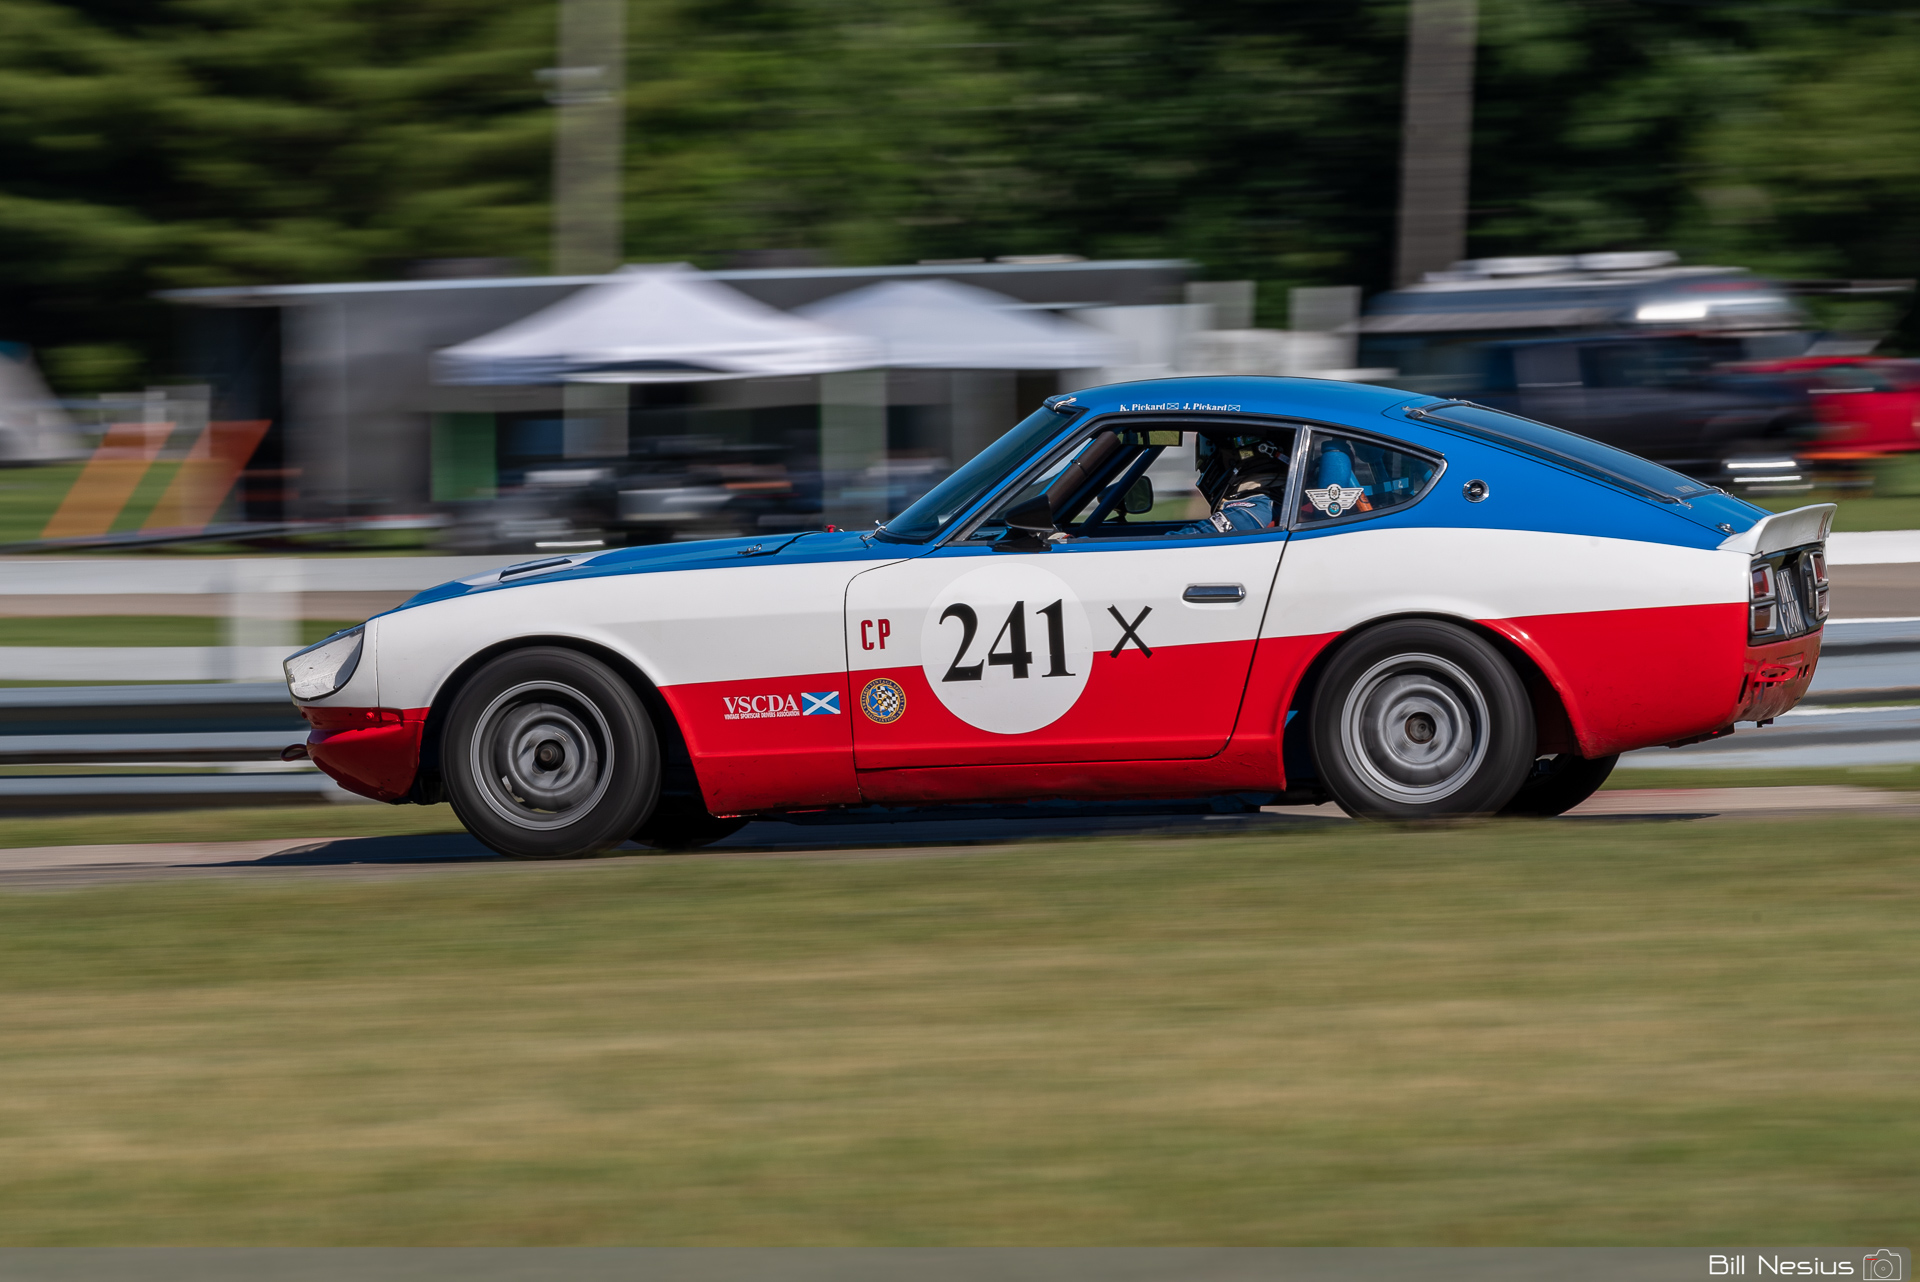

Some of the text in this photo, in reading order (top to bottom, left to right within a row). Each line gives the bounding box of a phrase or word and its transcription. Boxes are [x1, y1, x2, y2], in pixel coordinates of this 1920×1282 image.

[1119, 404, 1130, 412] K.
[1132, 403, 1166, 411] Pickard
[1193, 403, 1227, 412] Pickard
[860, 618, 891, 650] CP
[939, 598, 1076, 682] 241
[1107, 604, 1153, 658] X
[723, 694, 799, 714] VSCDA
